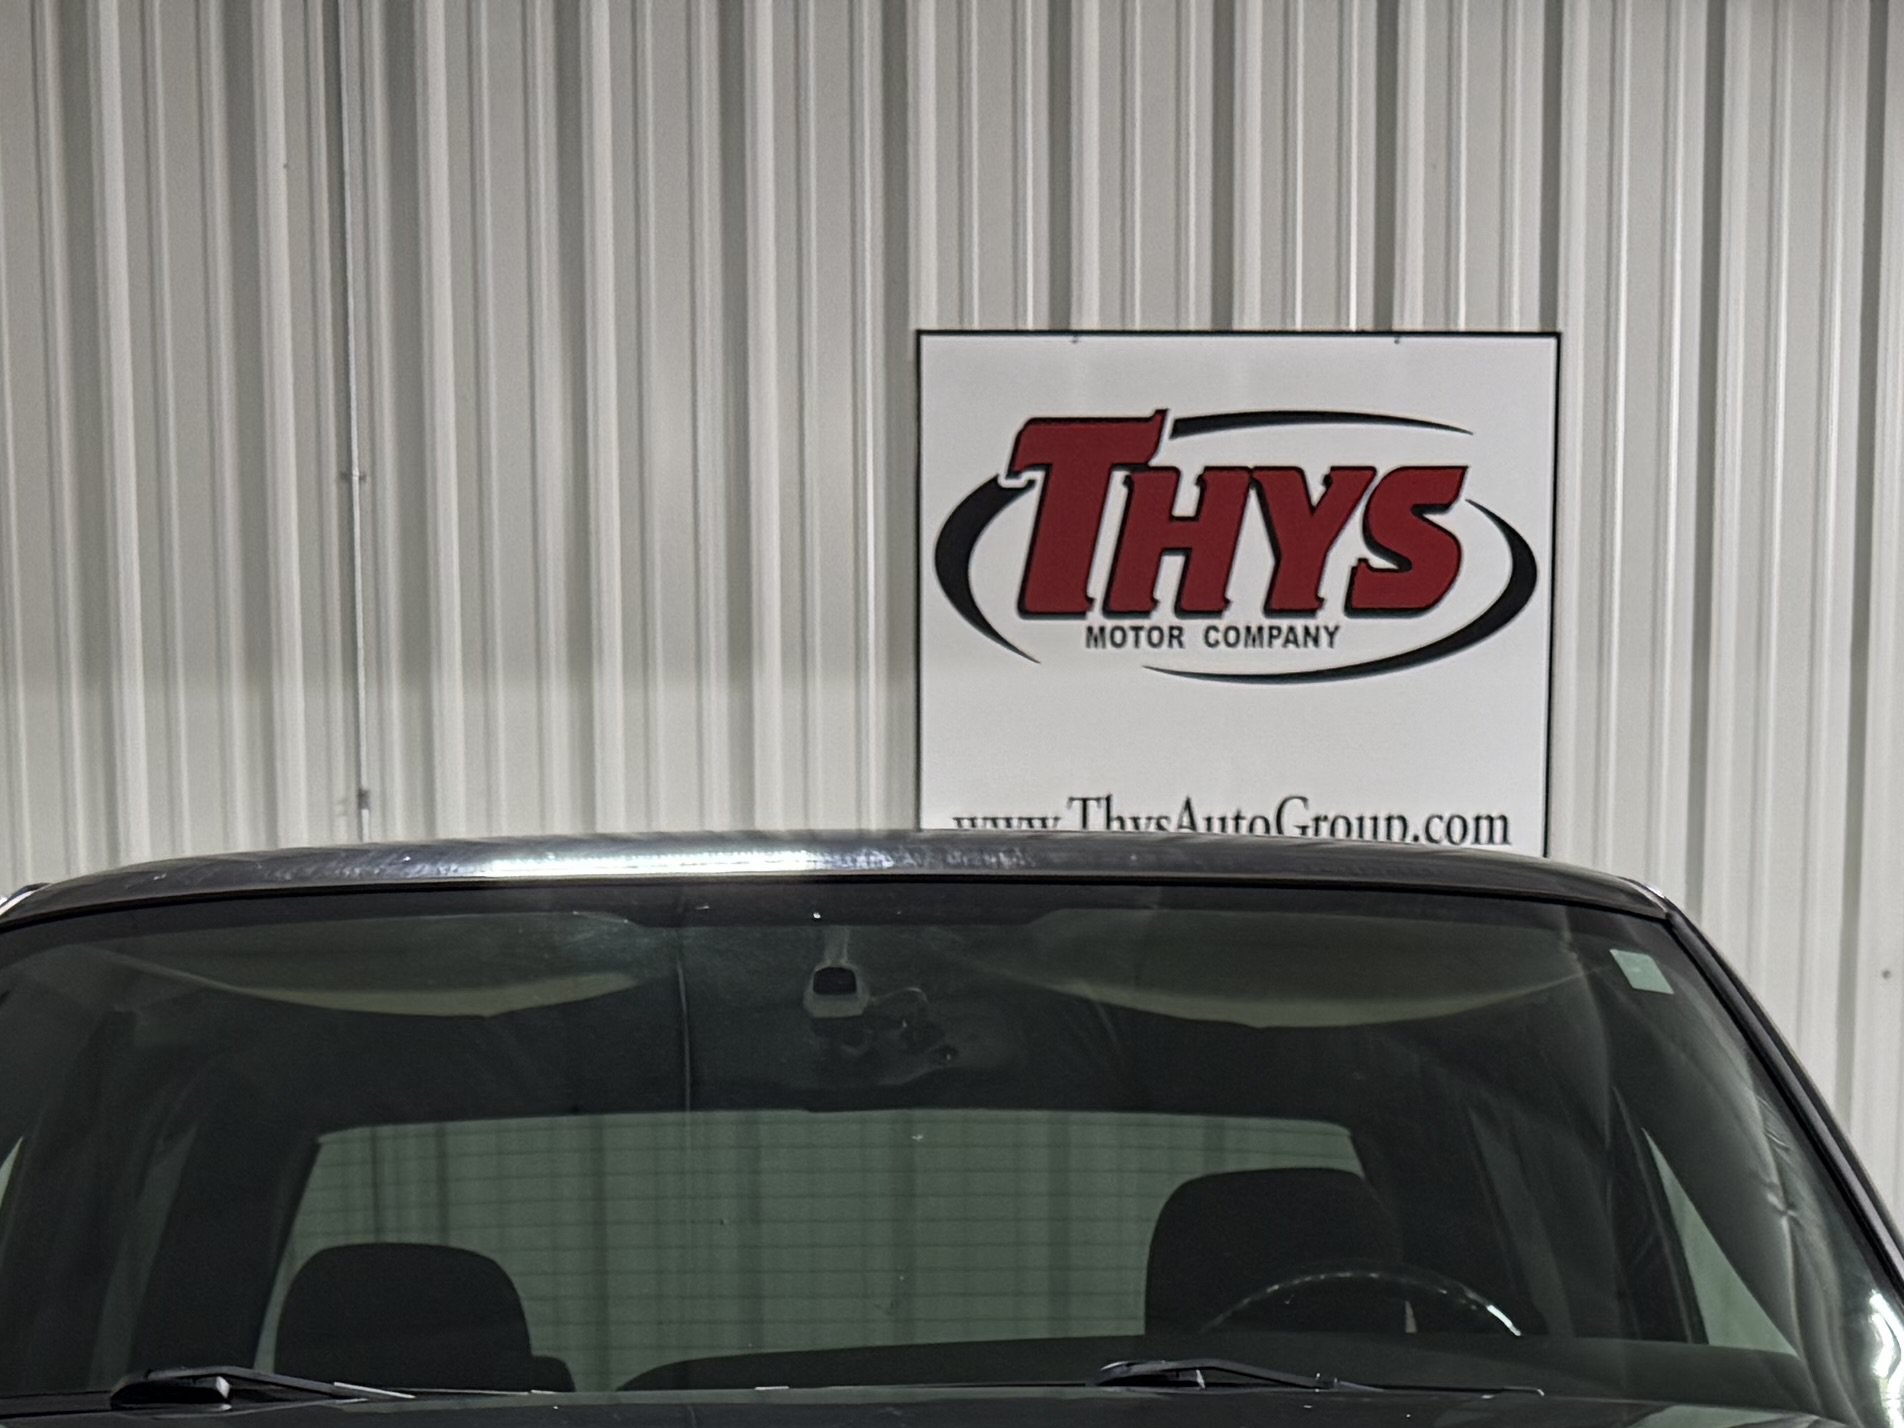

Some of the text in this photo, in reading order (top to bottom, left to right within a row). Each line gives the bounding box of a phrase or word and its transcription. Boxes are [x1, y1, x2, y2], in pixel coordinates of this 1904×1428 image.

[1007, 408, 1469, 620] THYS
[1085, 625, 1341, 650] MOTOR COMPANY
[952, 794, 1513, 847] ThsAutoGroup.com
